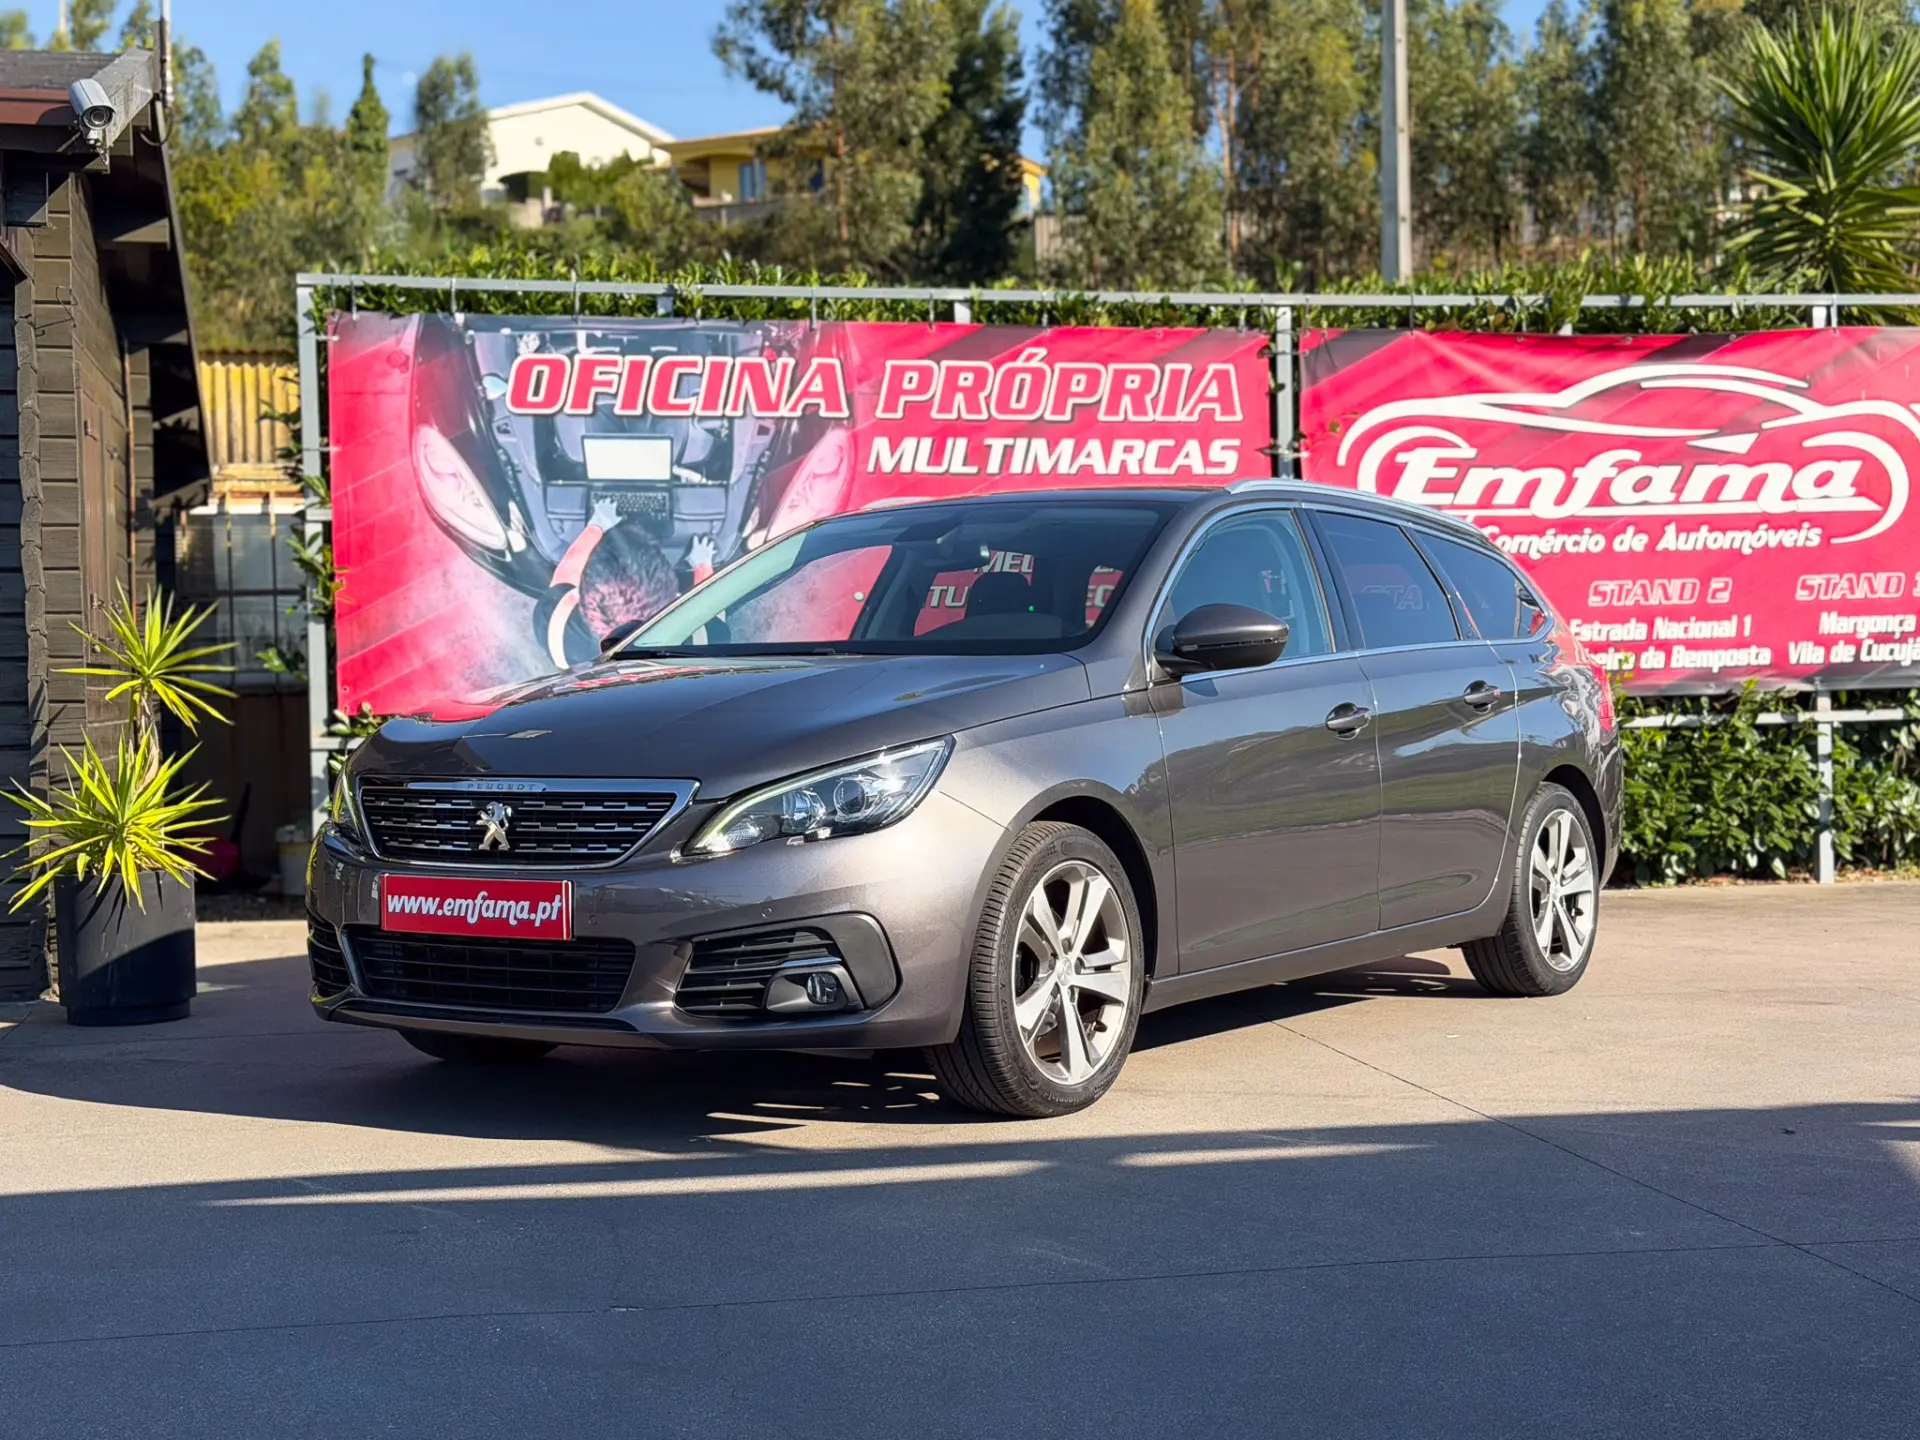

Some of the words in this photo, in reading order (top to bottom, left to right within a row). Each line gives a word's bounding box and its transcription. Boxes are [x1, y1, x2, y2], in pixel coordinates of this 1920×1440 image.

[505, 353, 849, 417] OFICINA
[875, 347, 1243, 423] PRÓPRIA
[867, 437, 1242, 475] MULTIMARCAS
[1394, 447, 1863, 519] Emfama
[1612, 525, 1649, 552] de
[1655, 521, 1823, 555] Automóveis
[1587, 577, 1701, 607] STAND
[1707, 576, 1733, 604] 2
[1795, 571, 1906, 601] STAND
[1569, 617, 1648, 642] Estrada
[1652, 614, 1738, 640] Nacional
[1743, 614, 1752, 637] 1
[1819, 611, 1917, 640] Margonça
[1640, 646, 1666, 669] da
[1670, 644, 1772, 673] Bemposta
[1788, 640, 1825, 665] Vila
[1829, 640, 1857, 663] de
[467, 783, 536, 791] PEUGEOT
[387, 890, 562, 927] www.emfama.pt
